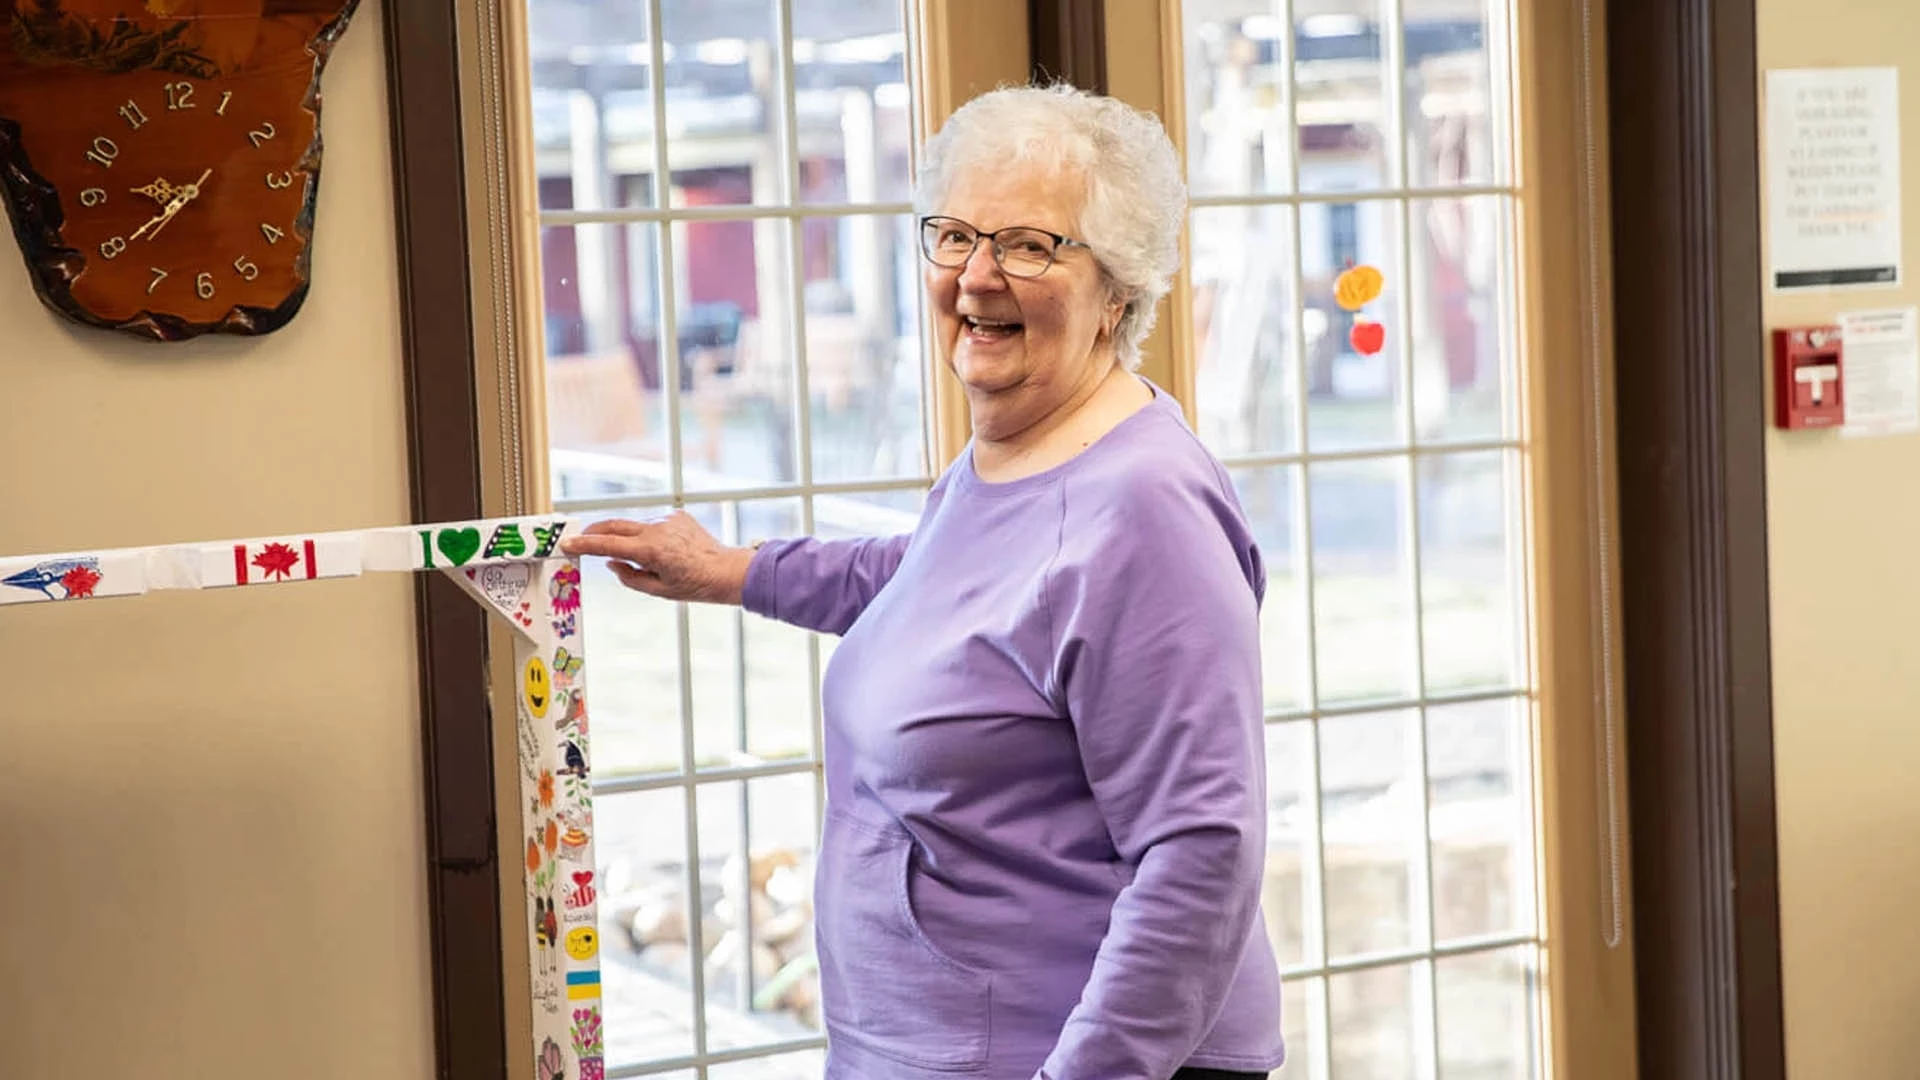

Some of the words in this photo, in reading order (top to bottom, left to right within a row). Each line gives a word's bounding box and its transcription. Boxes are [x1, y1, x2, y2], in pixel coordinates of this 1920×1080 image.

[164, 82, 196, 110] 12
[216, 91, 232, 116] 1
[119, 100, 149, 129] 11
[249, 122, 276, 148] 2
[87, 136, 119, 168] 10
[266, 171, 293, 190] 3
[80, 187, 107, 207] 9
[261, 223, 285, 244] 4
[100, 236, 126, 259] 8
[147, 267, 168, 293] 7
[234, 255, 258, 280] 5
[196, 273, 215, 299] 6
[418, 530, 436, 568] I
